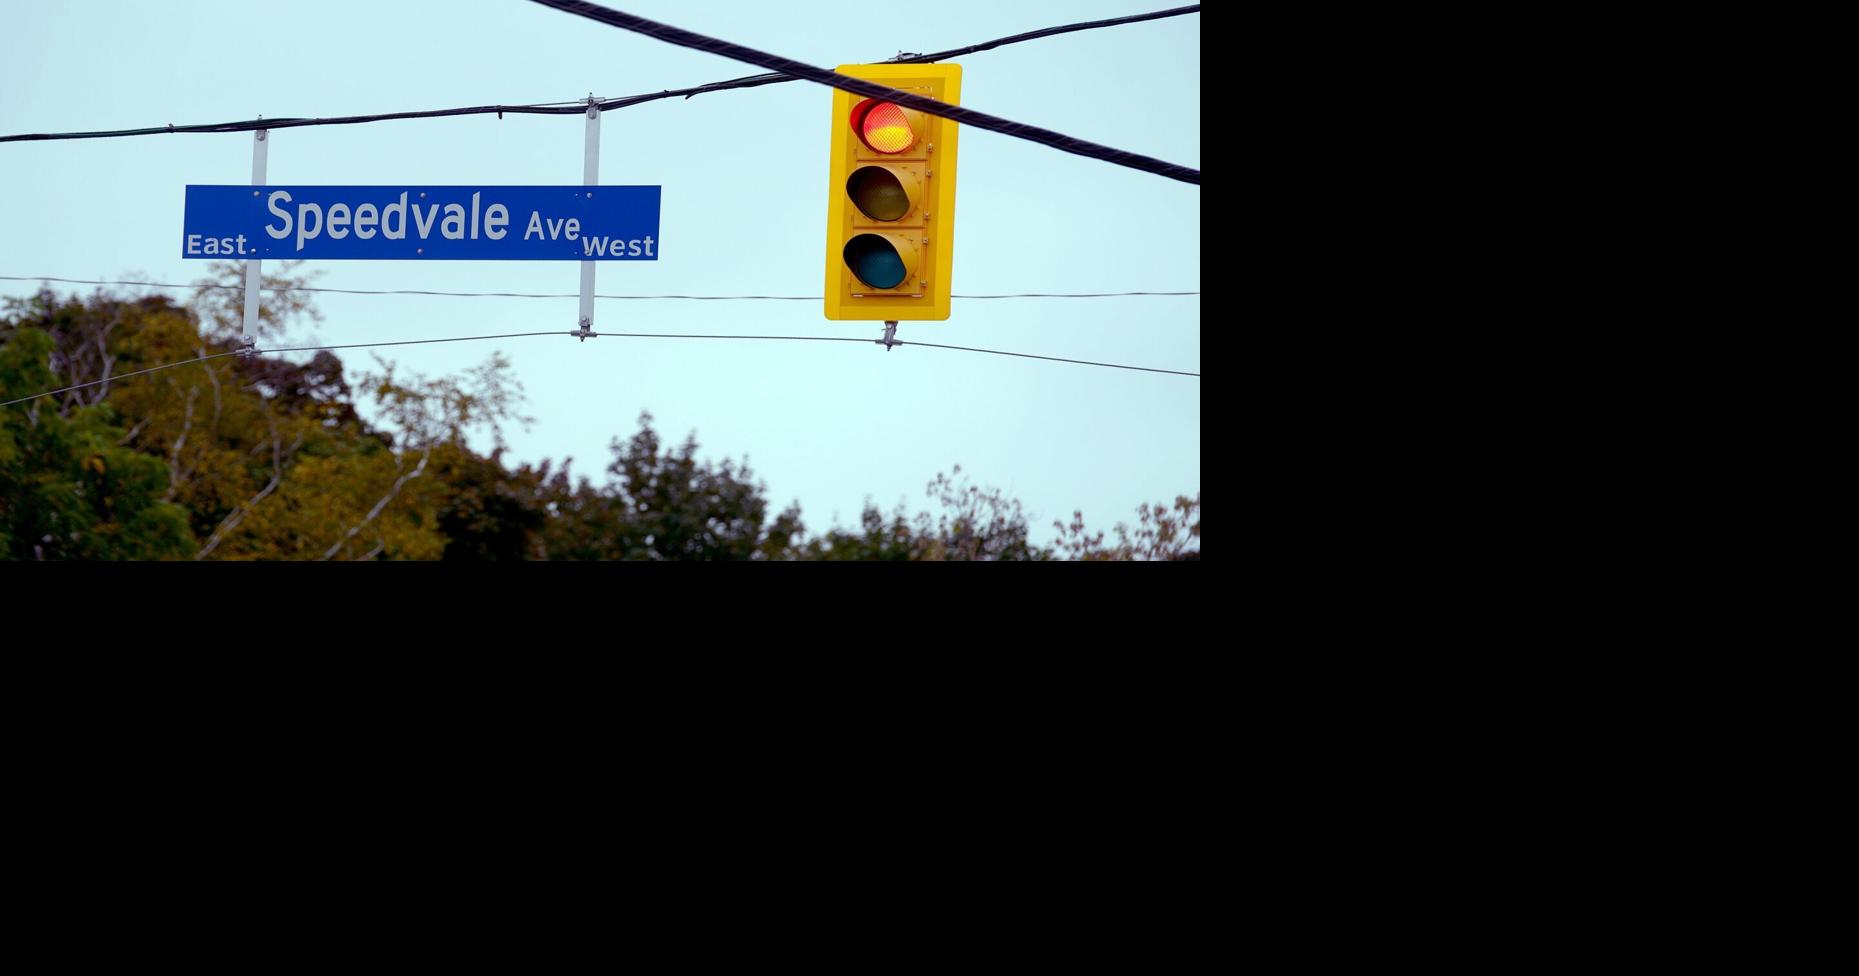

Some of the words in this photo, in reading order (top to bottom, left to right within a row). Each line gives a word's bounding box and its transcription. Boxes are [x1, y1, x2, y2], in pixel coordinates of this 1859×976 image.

[265, 190, 509, 251] Speedvale
[524, 211, 581, 241] Ave
[187, 234, 247, 255] East
[582, 235, 654, 257] West
